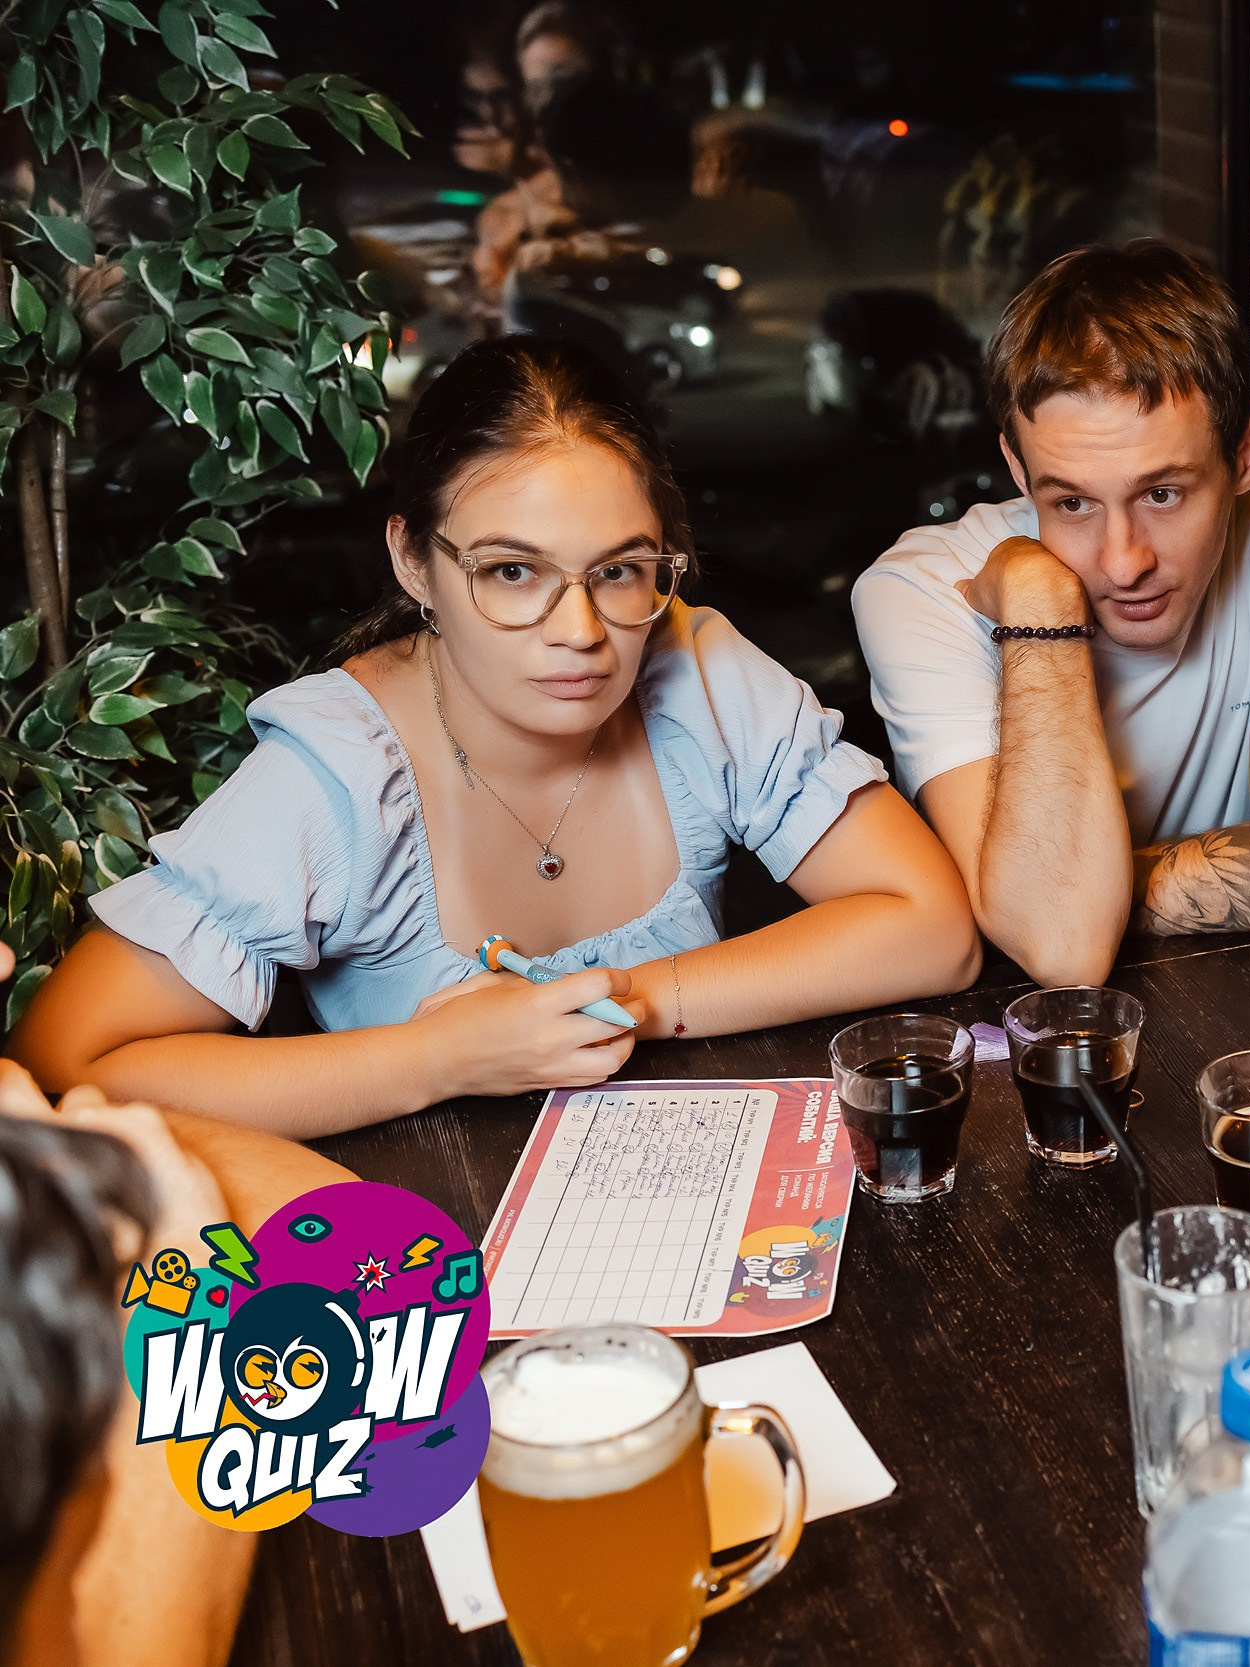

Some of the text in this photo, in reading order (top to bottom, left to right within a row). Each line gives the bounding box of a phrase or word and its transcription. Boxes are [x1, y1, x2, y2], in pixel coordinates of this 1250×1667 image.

[582, 1094, 593, 1108] ИТОГО
[797, 1091, 823, 1143] СОБЫТИЙ:
[816, 1123, 839, 1164] ВЕРСИЯ
[780, 1175, 789, 1186] ДЛЯ
[807, 1173, 815, 1181] ПО
[815, 1171, 829, 1209] ЗАПОЛНЯЕТСЯ
[743, 1256, 772, 1287] QUIZ
[767, 1241, 809, 1299] WOW
[696, 1298, 704, 1308] ТУР
